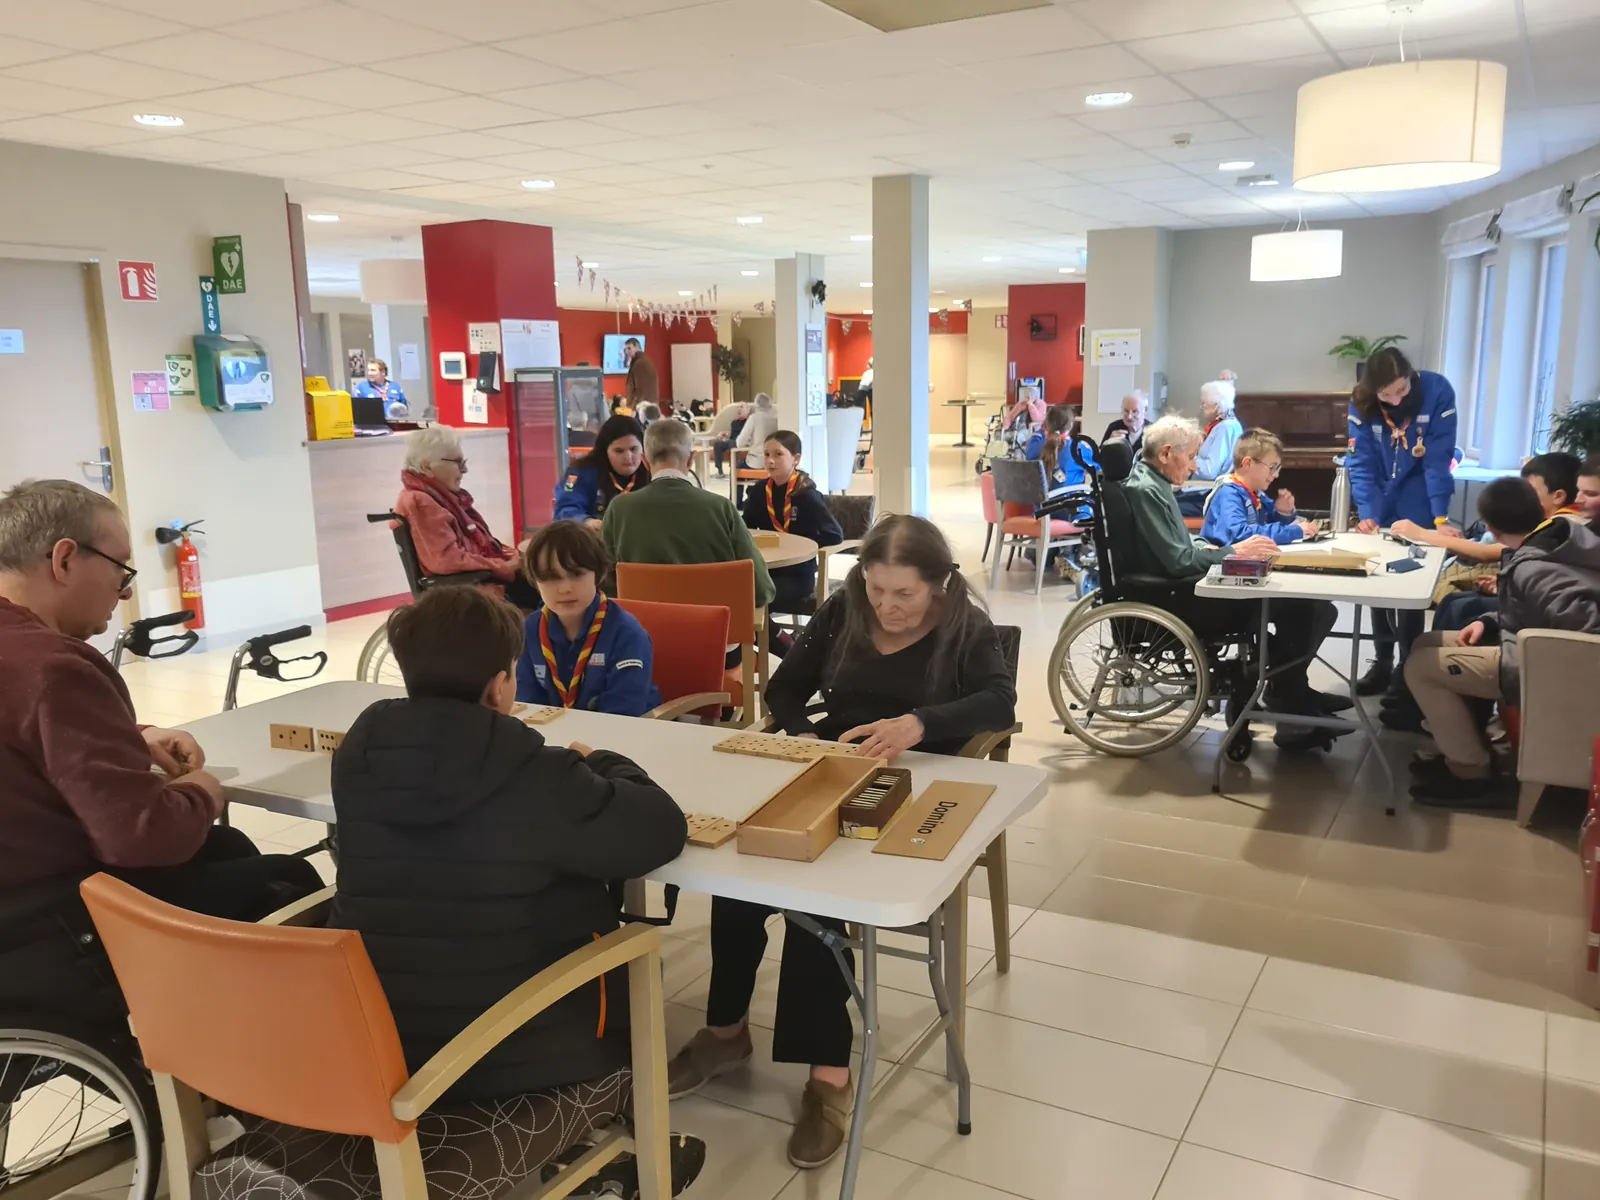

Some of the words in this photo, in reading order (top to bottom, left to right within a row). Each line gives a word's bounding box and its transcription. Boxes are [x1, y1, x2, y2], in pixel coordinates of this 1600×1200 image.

[222, 279, 243, 290] DAE
[206, 294, 215, 319] DAE
[917, 801, 958, 835] Domino
